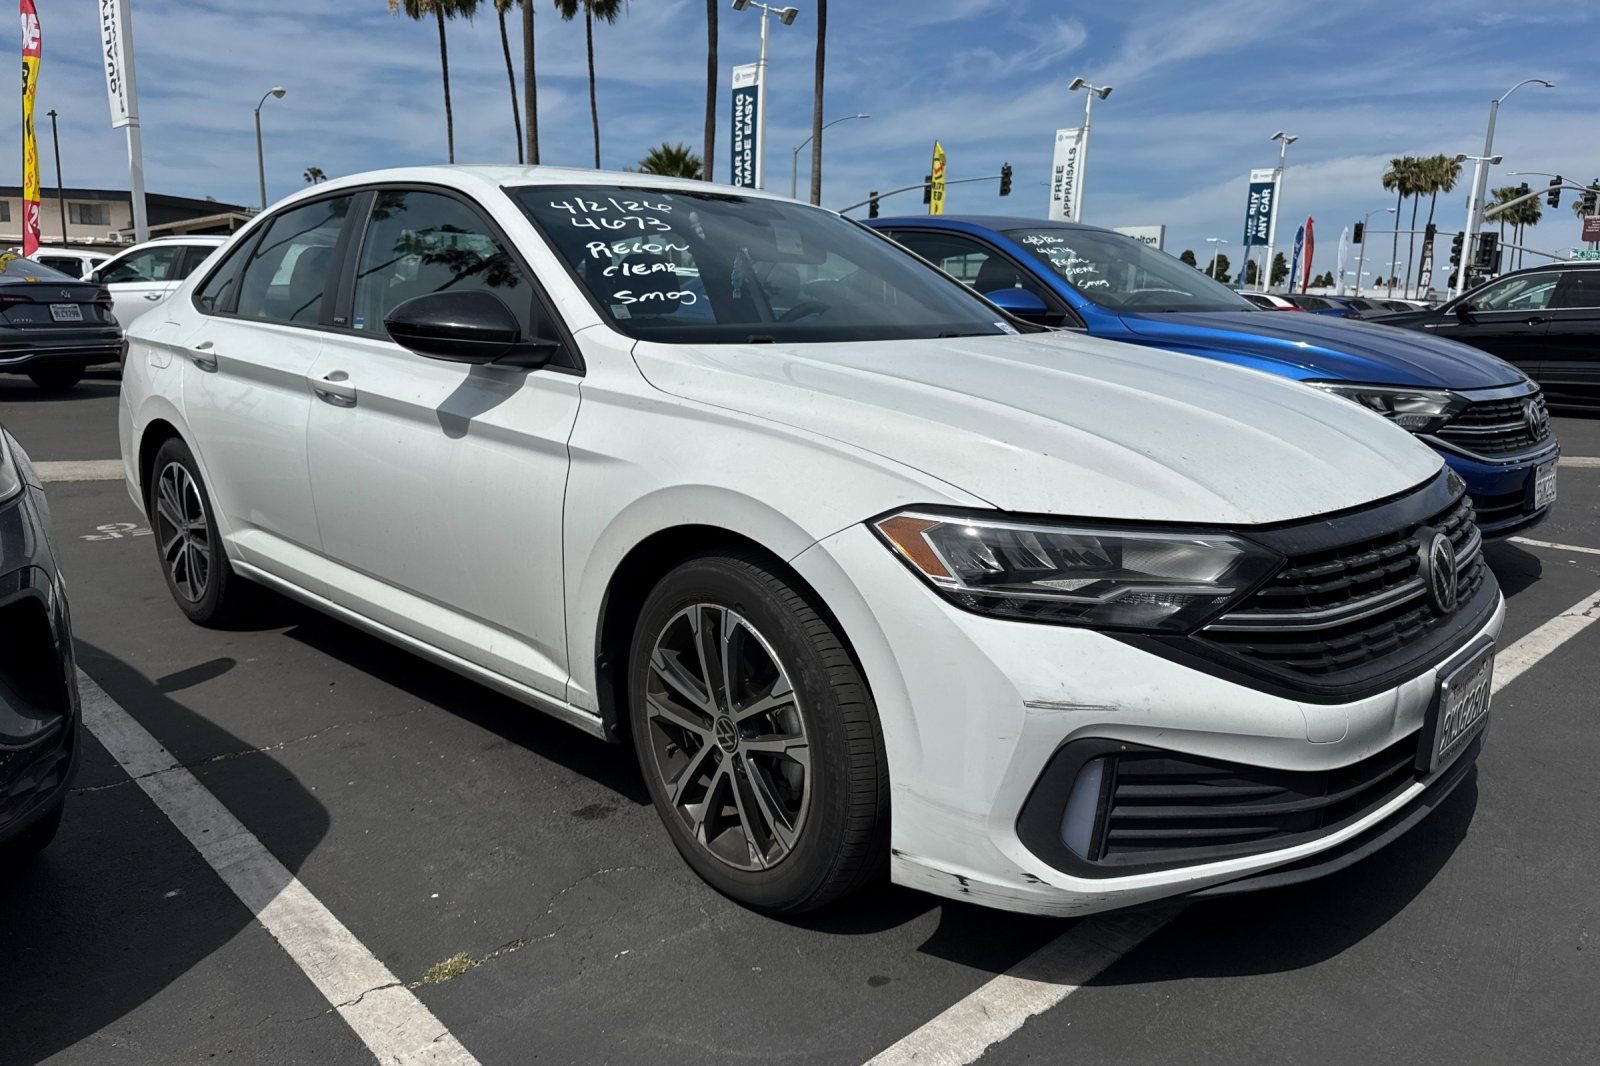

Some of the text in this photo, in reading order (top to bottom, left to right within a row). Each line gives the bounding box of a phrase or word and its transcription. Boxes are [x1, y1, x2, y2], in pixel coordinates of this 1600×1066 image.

[735, 93, 744, 187] CAR BUYING
[744, 95, 754, 184] MADE EASY
[1054, 164, 1064, 201] FREE
[1063, 147, 1077, 218] APPRAISALS
[1260, 188, 1271, 213] CAR
[572, 216, 671, 230] 4673
[1257, 215, 1268, 239] ANY
